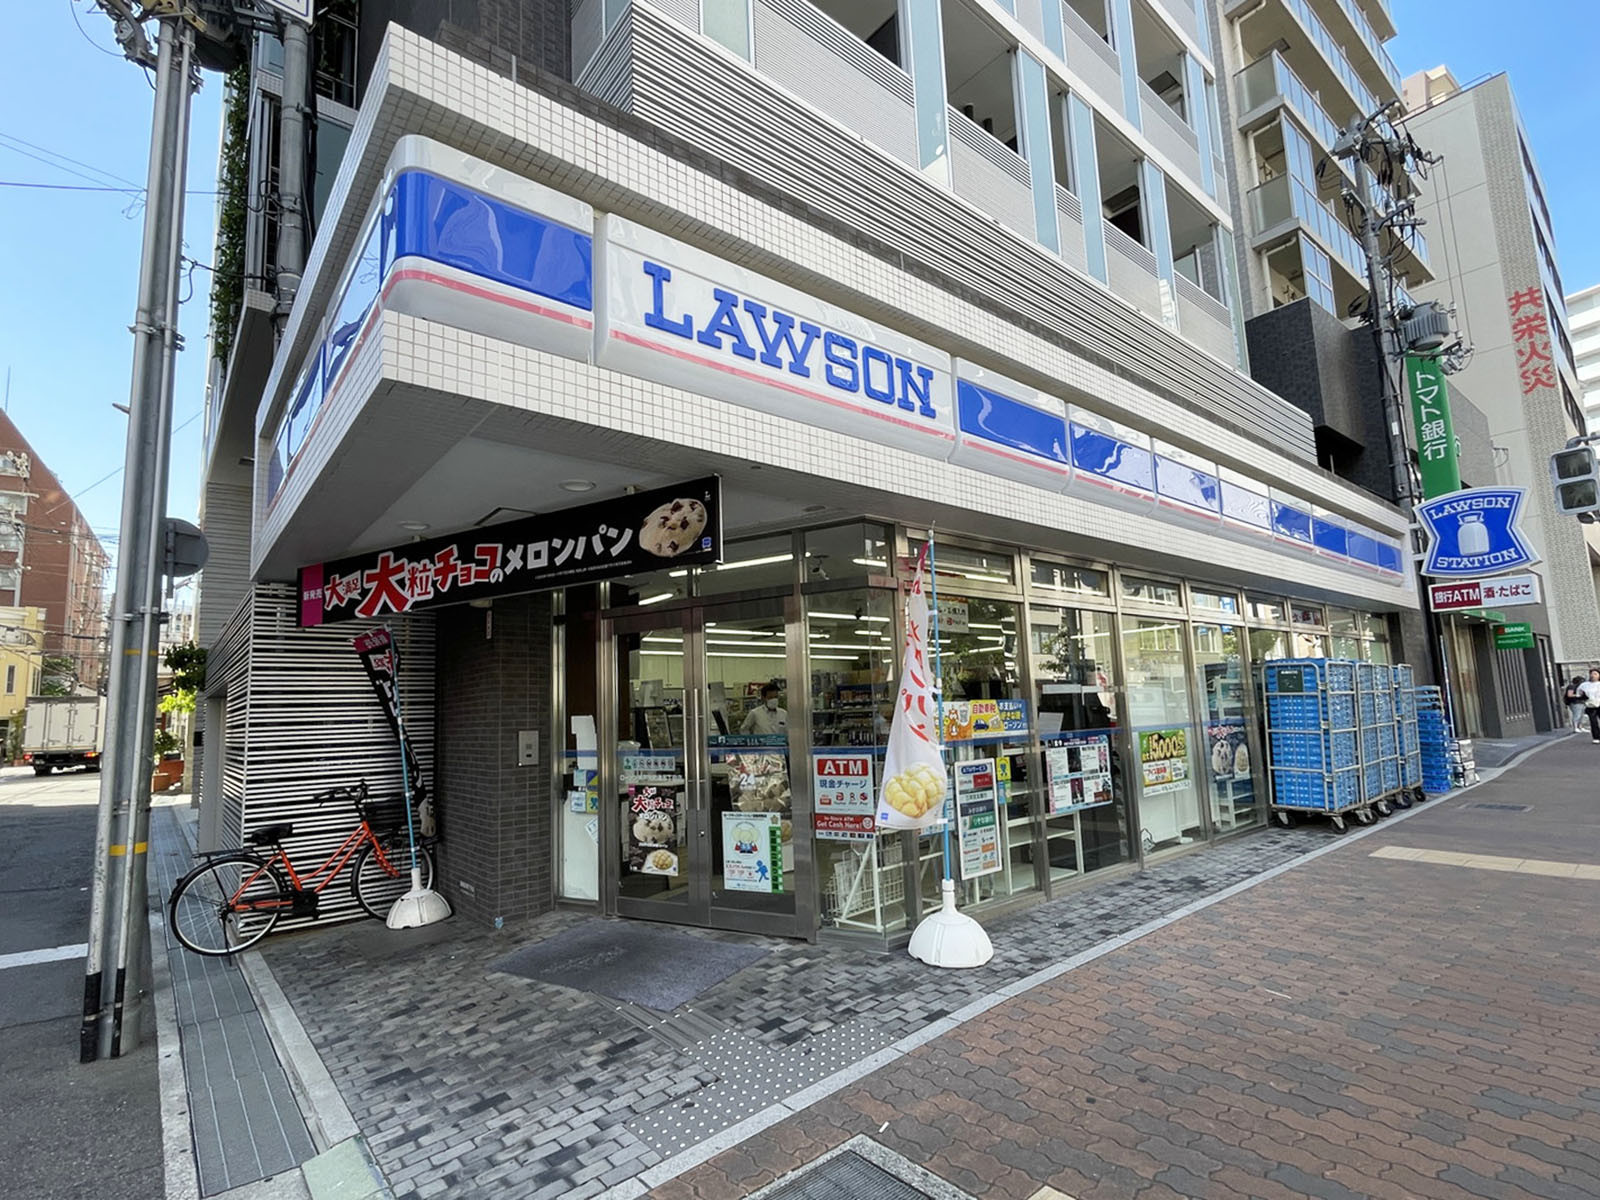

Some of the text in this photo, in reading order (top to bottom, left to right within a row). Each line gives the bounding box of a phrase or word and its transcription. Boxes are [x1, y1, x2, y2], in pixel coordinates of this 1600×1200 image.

[643, 260, 937, 419] LAWSON
[1508, 286, 1556, 396] 共栄火災
[1415, 370, 1449, 461] トマト銀行
[1429, 497, 1511, 520] LAWSON
[1436, 548, 1519, 568] STATION
[1434, 584, 1531, 604] 銀行ATM 酒・たばこ
[823, 760, 862, 775] ATM
[819, 779, 867, 789] 現金チャージ
[816, 820, 827, 828] Get
[828, 820, 843, 828] Cash
